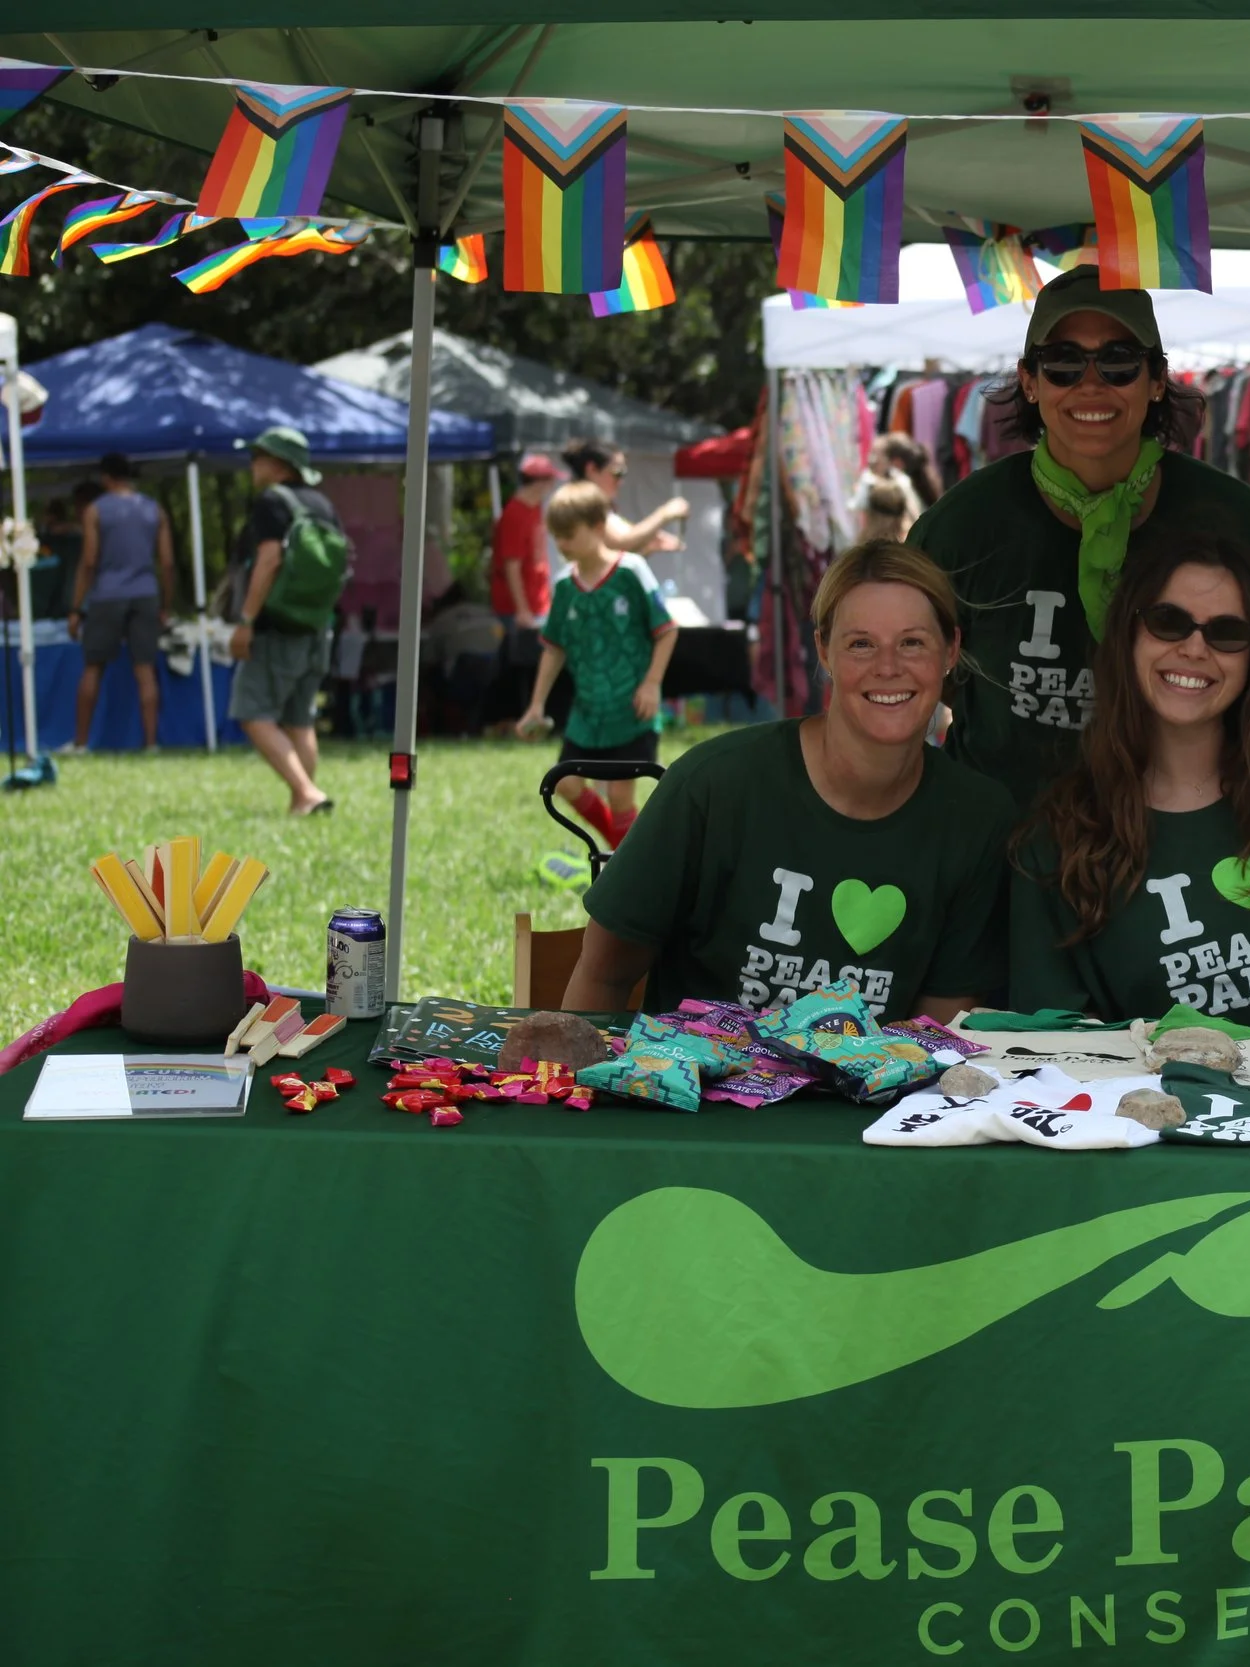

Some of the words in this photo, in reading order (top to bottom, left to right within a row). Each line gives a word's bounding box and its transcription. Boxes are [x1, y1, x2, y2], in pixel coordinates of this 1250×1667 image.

[1018, 590, 1067, 660] I
[1009, 661, 1097, 699] PEA
[759, 867, 814, 947] I
[1145, 873, 1205, 945] I
[740, 944, 894, 1004] PEASE
[818, 1018, 841, 1030] ETE
[589, 1456, 1065, 1581] Pease
